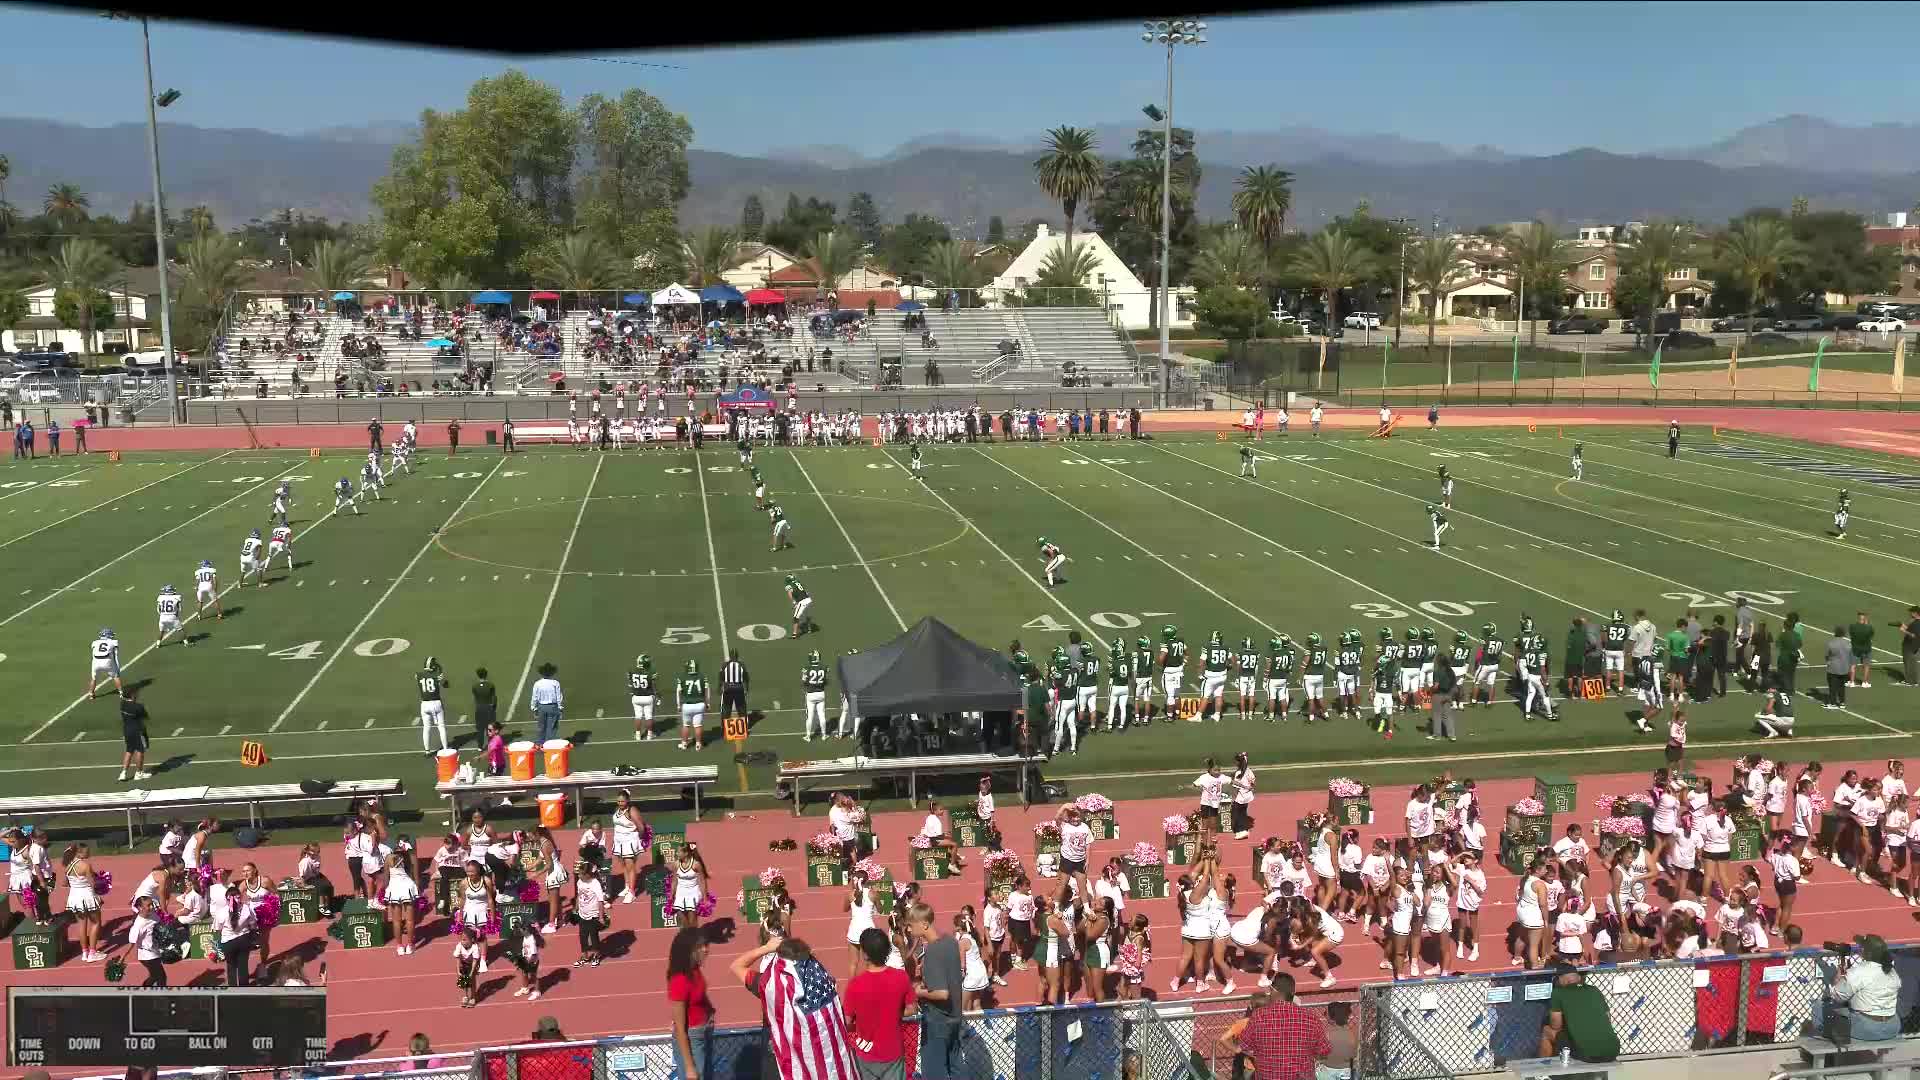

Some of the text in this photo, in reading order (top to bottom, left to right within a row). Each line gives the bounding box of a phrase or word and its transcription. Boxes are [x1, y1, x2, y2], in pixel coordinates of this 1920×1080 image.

[244, 541, 253, 552] 8
[199, 571, 211, 583] 10
[160, 600, 174, 613] 16
[1350, 600, 1475, 619] 30
[1022, 612, 1142, 629] 40
[660, 623, 787, 645] 50
[1609, 627, 1626, 641] 52
[98, 642, 108, 653] 6
[267, 640, 411, 661] 40
[1408, 645, 1423, 659] 57
[1211, 650, 1227, 665] 58
[1242, 655, 1257, 669] 28
[1525, 653, 1537, 668] 12
[808, 669, 825, 684] 22
[1119, 664, 1128, 678] 9
[419, 677, 436, 693] 18
[632, 674, 648, 689] 55
[685, 680, 702, 695] 71
[1588, 680, 1603, 696] 30
[1779, 692, 1790, 706] 5
[1182, 700, 1199, 716] 40
[727, 718, 746, 736] 50
[243, 743, 258, 762] 40
